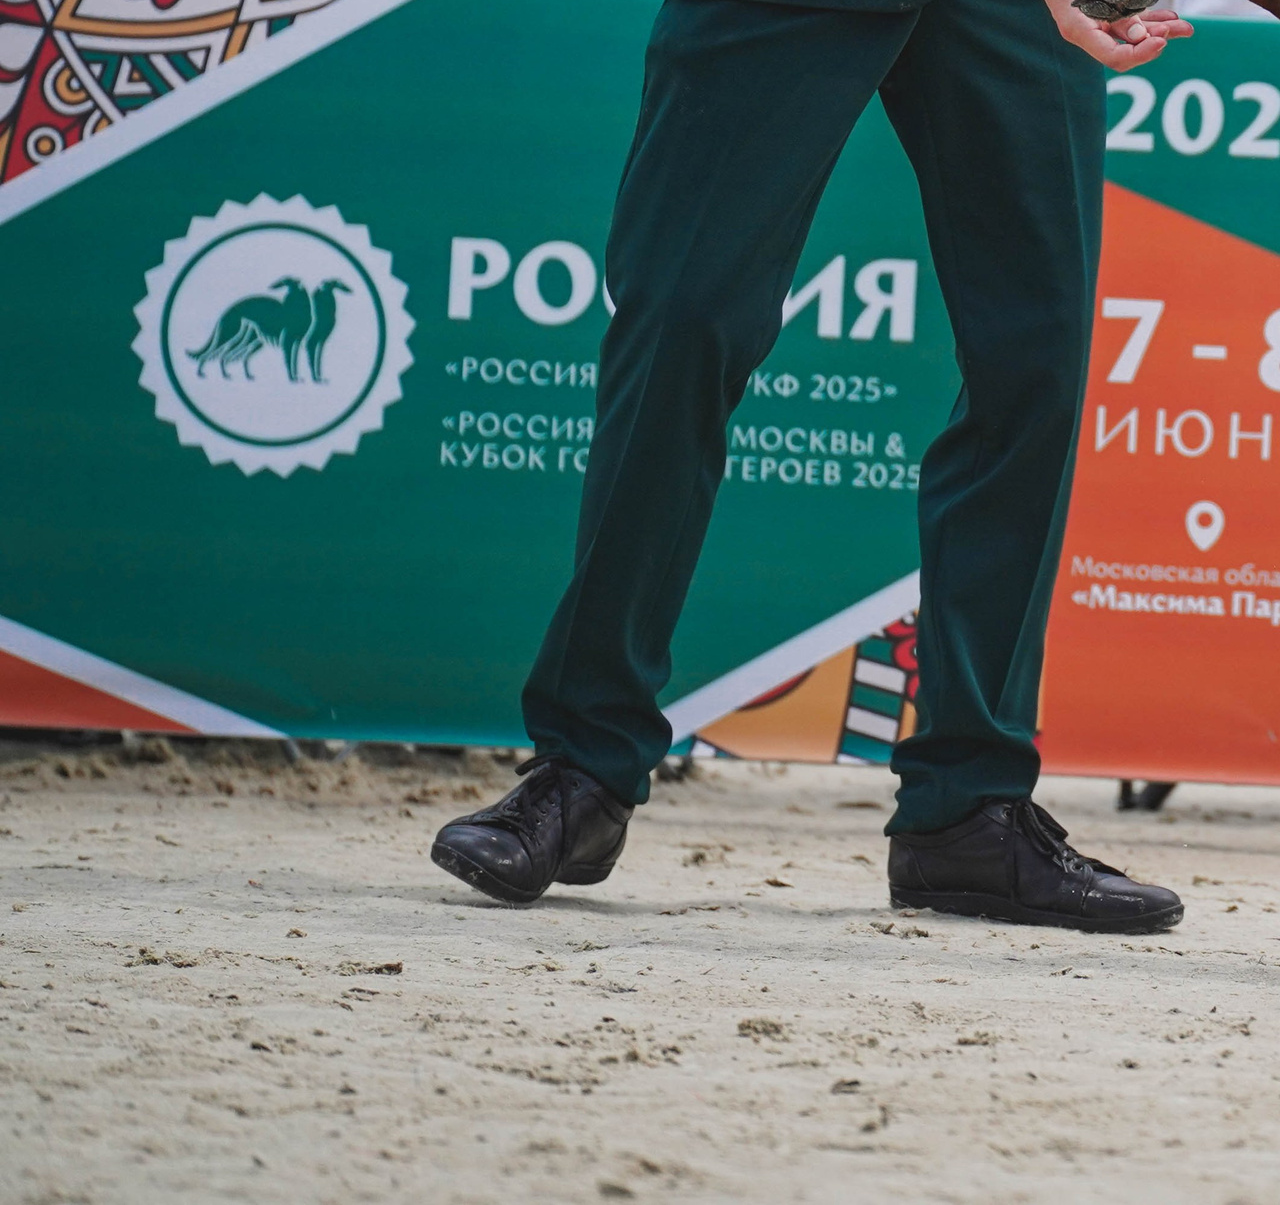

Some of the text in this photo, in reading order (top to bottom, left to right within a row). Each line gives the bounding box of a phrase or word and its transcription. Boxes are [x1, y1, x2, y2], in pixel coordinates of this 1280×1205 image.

[448, 236, 918, 342] РОИЯ
[1102, 297, 1165, 384] 7
[748, 372, 799, 398] КФ
[809, 373, 898, 403] 2025»
[731, 424, 875, 457] МОСКВЫ
[885, 431, 905, 459] &
[440, 440, 546, 473] КУБОК
[724, 454, 842, 487] ГЕРОЕВ
[1071, 554, 1219, 585] Московская
[1071, 583, 1225, 617] «Максима
